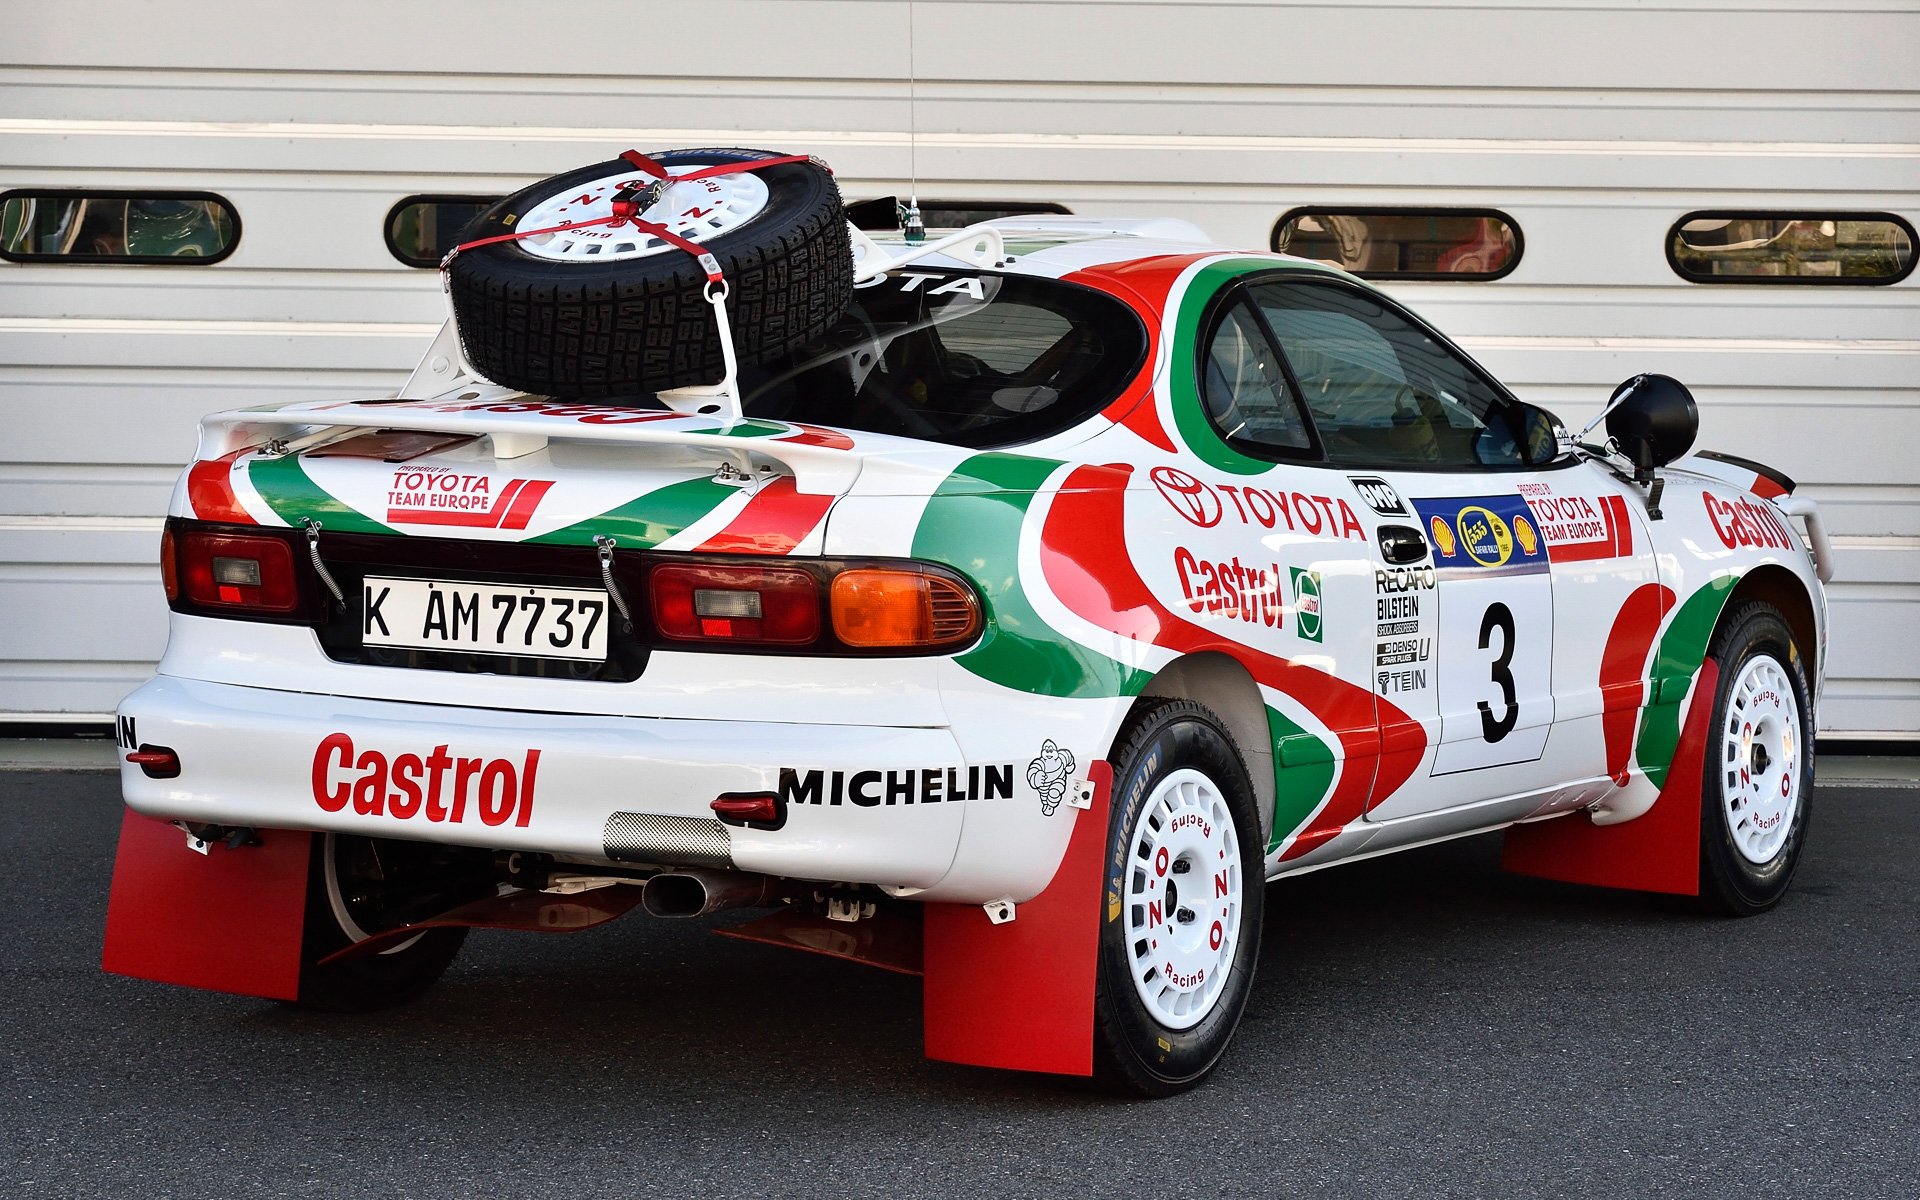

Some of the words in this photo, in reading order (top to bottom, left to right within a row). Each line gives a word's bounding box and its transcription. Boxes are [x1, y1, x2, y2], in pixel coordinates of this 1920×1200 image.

[559, 219, 613, 239] Rcing
[398, 465, 438, 473] PREPARED
[393, 472, 490, 494] TOYOTA
[1517, 483, 1545, 496] PREPARED
[1541, 483, 1553, 495] BY
[388, 491, 426, 507] TEAM
[430, 495, 489, 510] EUROPE
[1357, 484, 1399, 509] OMP
[1527, 496, 1597, 522] TOYOTA
[1215, 484, 1367, 541] TOYOTA
[1702, 490, 1796, 552] Castrol
[1467, 520, 1488, 545] 555
[1540, 524, 1568, 541] TEAM
[1566, 521, 1605, 539] EUROPE
[1174, 546, 1283, 630] Castrol
[1375, 565, 1436, 594] RECARO
[365, 585, 391, 638] K
[423, 590, 479, 642] AM
[492, 594, 603, 648] 7737
[1301, 594, 1319, 614] Castrol
[1377, 595, 1419, 620] BILSTEIN
[1378, 624, 1394, 635] SHOCK
[1393, 622, 1418, 634] ABSORBERS
[1392, 639, 1418, 653] DENSO
[1382, 655, 1397, 665] SPARK
[1397, 653, 1412, 663] PLUGS
[1391, 669, 1427, 692] TEIN
[1477, 602, 1518, 744] 3
[1753, 691, 1780, 708] Racing
[117, 714, 138, 750] IN
[312, 732, 542, 828] Castrol
[778, 764, 1014, 808] MICHELIN
[1115, 752, 1158, 870] MICHELIN
[1753, 812, 1780, 829] Racing
[1172, 813, 1212, 840] Racing
[1165, 961, 1205, 988] Racing
